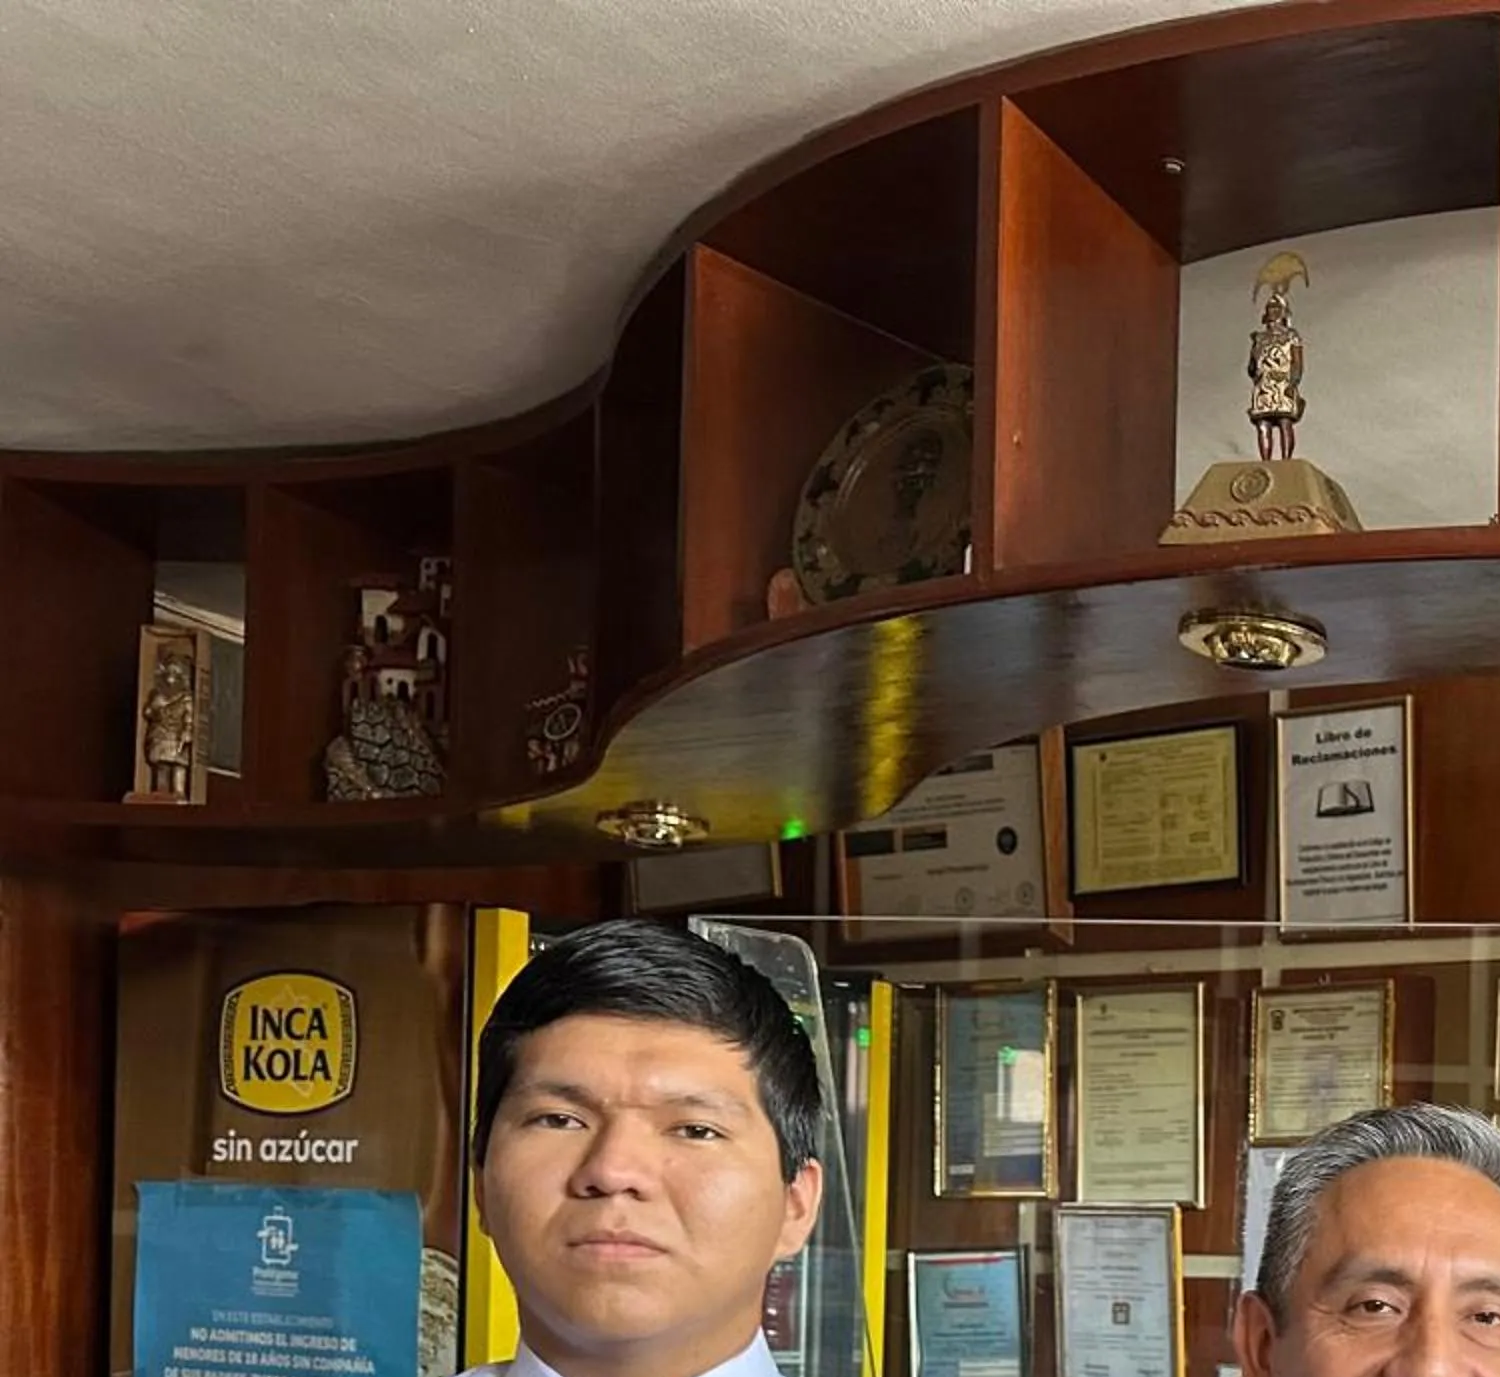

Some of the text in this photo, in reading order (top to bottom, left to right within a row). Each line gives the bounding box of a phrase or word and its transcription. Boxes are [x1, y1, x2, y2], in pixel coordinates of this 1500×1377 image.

[1315, 727, 1372, 744] Libro de
[1292, 745, 1398, 766] Reclamaciones
[250, 1005, 328, 1041] INCA
[243, 1045, 332, 1082] KOLA
[213, 1129, 358, 1163] sin azúcar
[190, 1328, 357, 1352] NO ADMITIMOS EL INGRESO DE
[173, 1347, 227, 1363] MENORES
[229, 1350, 243, 1364] DE
[260, 1350, 291, 1368] AÑOS
[293, 1355, 311, 1370] SIN
[312, 1355, 375, 1374] COMPAÑÍA
